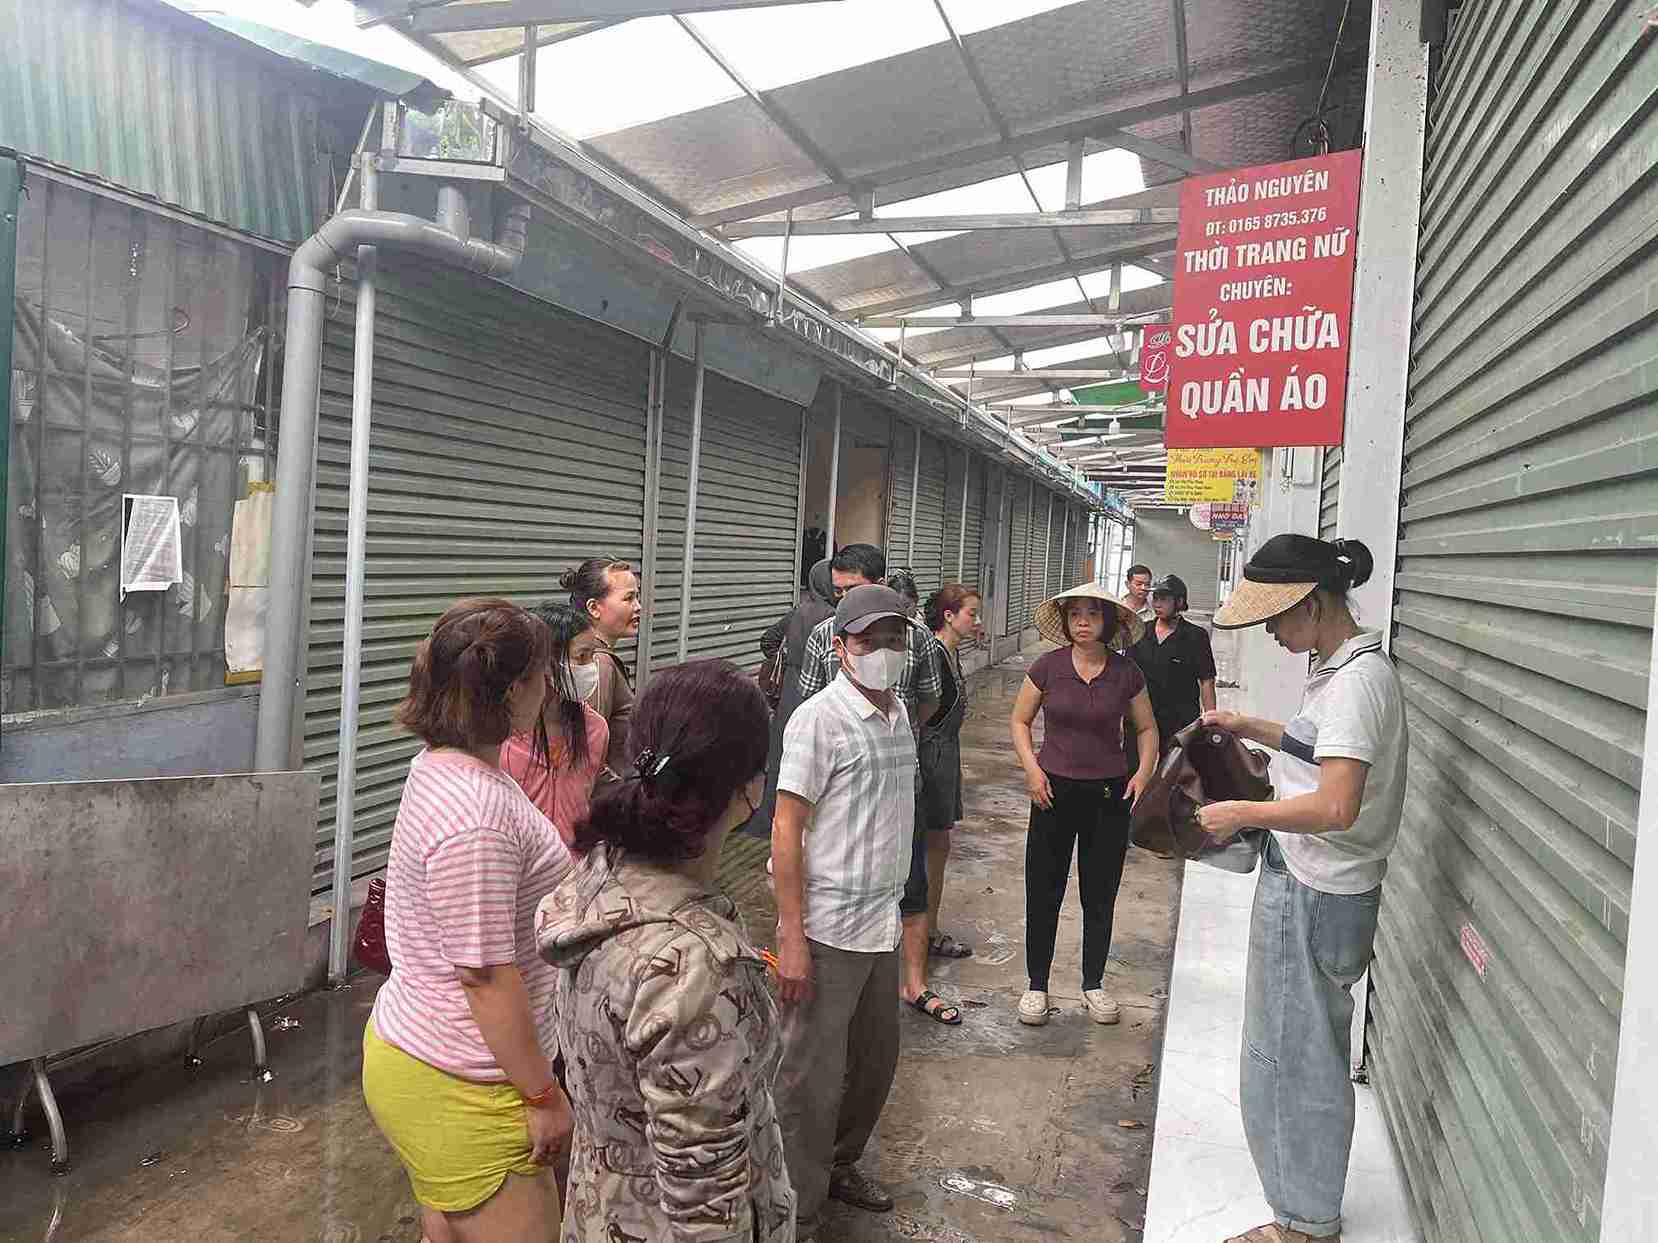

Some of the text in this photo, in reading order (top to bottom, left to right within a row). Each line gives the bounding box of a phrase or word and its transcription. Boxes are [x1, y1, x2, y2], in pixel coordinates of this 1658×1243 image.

[1205, 169, 1329, 207] THẢO NGUYÊN
[1229, 216, 1261, 233] 0165
[1264, 206, 1327, 229] 8735.376
[1184, 227, 1350, 273] THỜI TRANG NỮ
[1220, 275, 1292, 301] CHUYÊN:
[1175, 305, 1340, 358] SỬA CHỮA
[1180, 367, 1270, 420] QUẦN
[1280, 364, 1328, 411] ÁO
